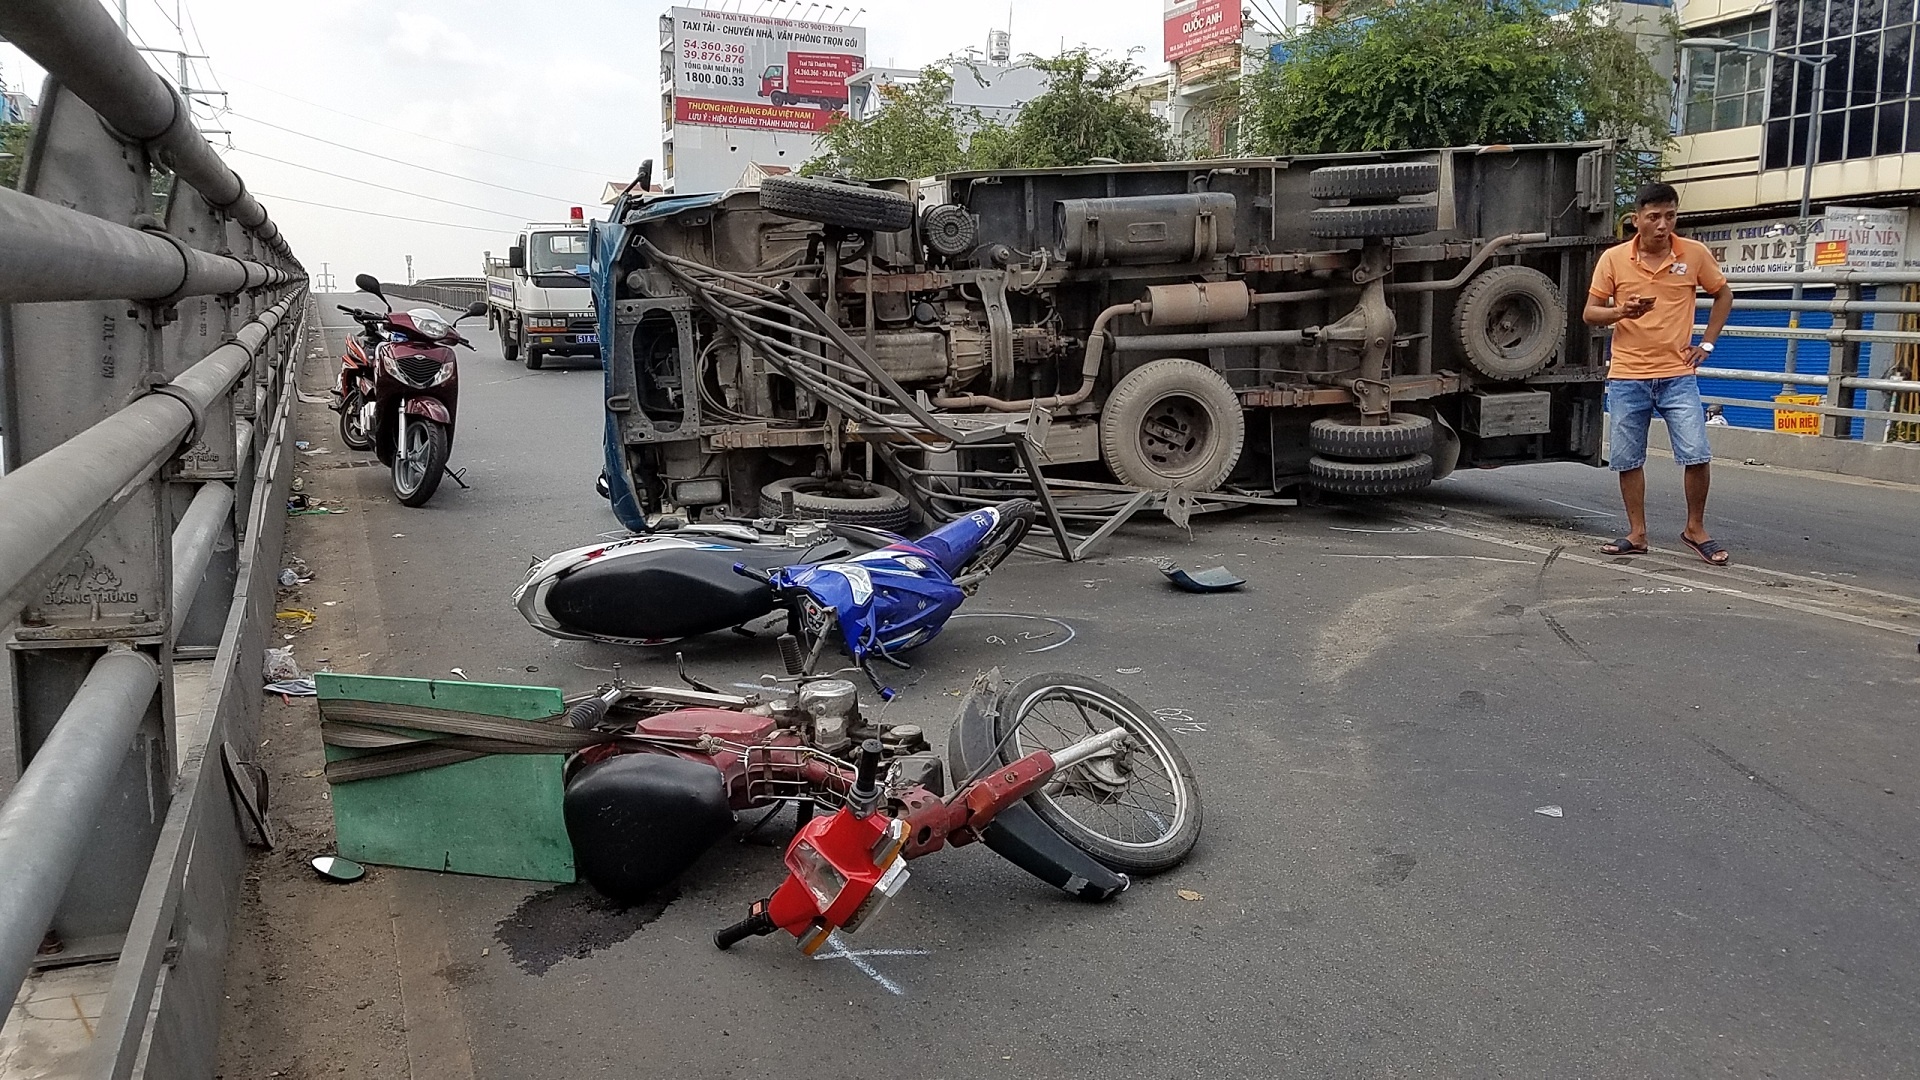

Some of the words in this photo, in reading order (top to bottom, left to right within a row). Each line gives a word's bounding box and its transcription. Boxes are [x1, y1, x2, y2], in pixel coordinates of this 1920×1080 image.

[701, 11, 720, 19] HÃNG
[750, 16, 773, 25] THÀNH
[774, 19, 793, 27] HƯNG
[810, 23, 843, 33] 9001:2015
[1183, 16, 1205, 33] QUỐC
[1206, 11, 1222, 26] ANH
[682, 21, 700, 31] TAXI
[703, 21, 715, 32] TẢI
[777, 30, 793, 40] VĂN
[795, 32, 821, 44] PHÒNG
[823, 36, 844, 47] TRỌN
[844, 37, 858, 48] GÓI
[684, 39, 744, 54] 54.360.360
[684, 50, 744, 64] 39.876.876
[685, 72, 744, 87] 1800.00.33
[688, 102, 720, 112] THƯƠNG
[721, 104, 738, 114] HIỆU
[740, 106, 760, 114] HÀNG
[778, 109, 793, 119] VIỆT
[712, 114, 727, 123] HIỆN
[728, 115, 737, 123] CÓ
[758, 118, 780, 127] THÀNH
[1692, 230, 1732, 242] TNHH
[1778, 415, 1797, 429] BÚN
[1800, 415, 1818, 429] RIÊU
[44, 593, 90, 605] QUANG
[94, 592, 138, 603] TRUNG
